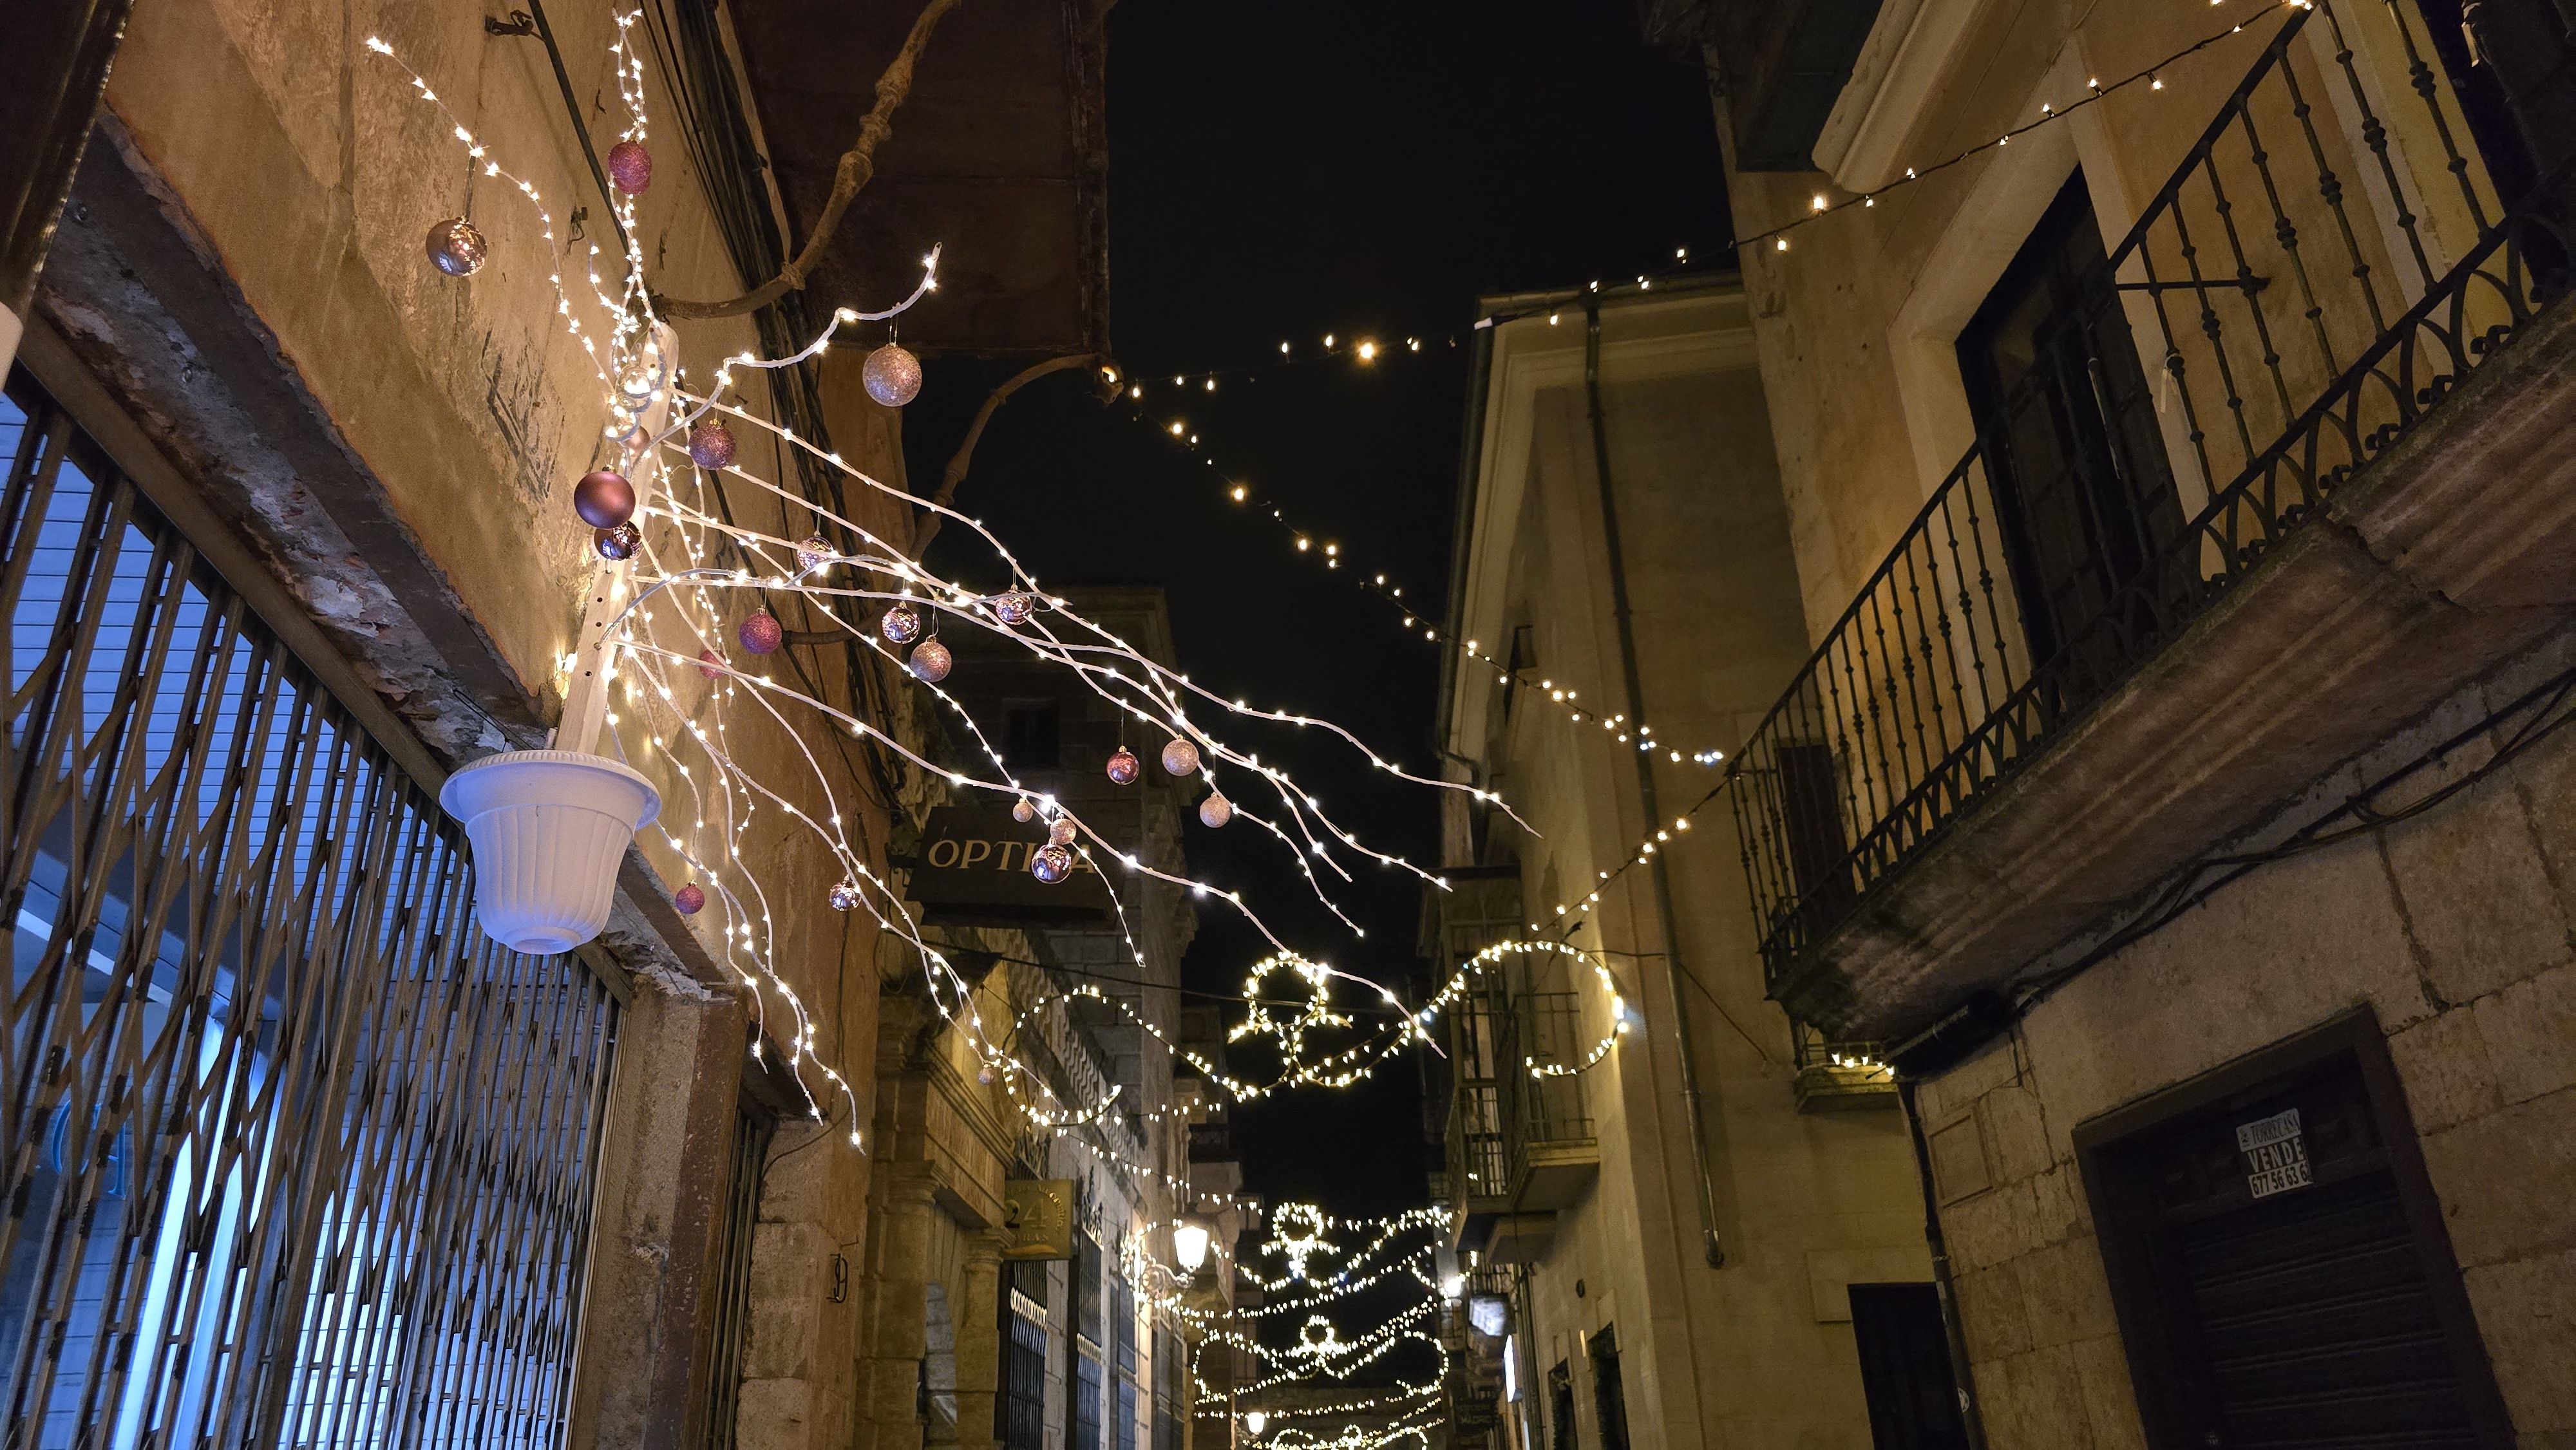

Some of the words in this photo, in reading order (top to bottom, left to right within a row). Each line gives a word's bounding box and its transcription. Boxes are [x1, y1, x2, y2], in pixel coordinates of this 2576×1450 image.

[928, 839, 1097, 873] OPTIA
[2247, 1138, 2304, 1172] VENDE
[2251, 1174, 2269, 1195] 677
[2271, 1170, 2284, 1190] 56
[2285, 1166, 2300, 1186] 63
[1005, 1199, 1048, 1228] 24
